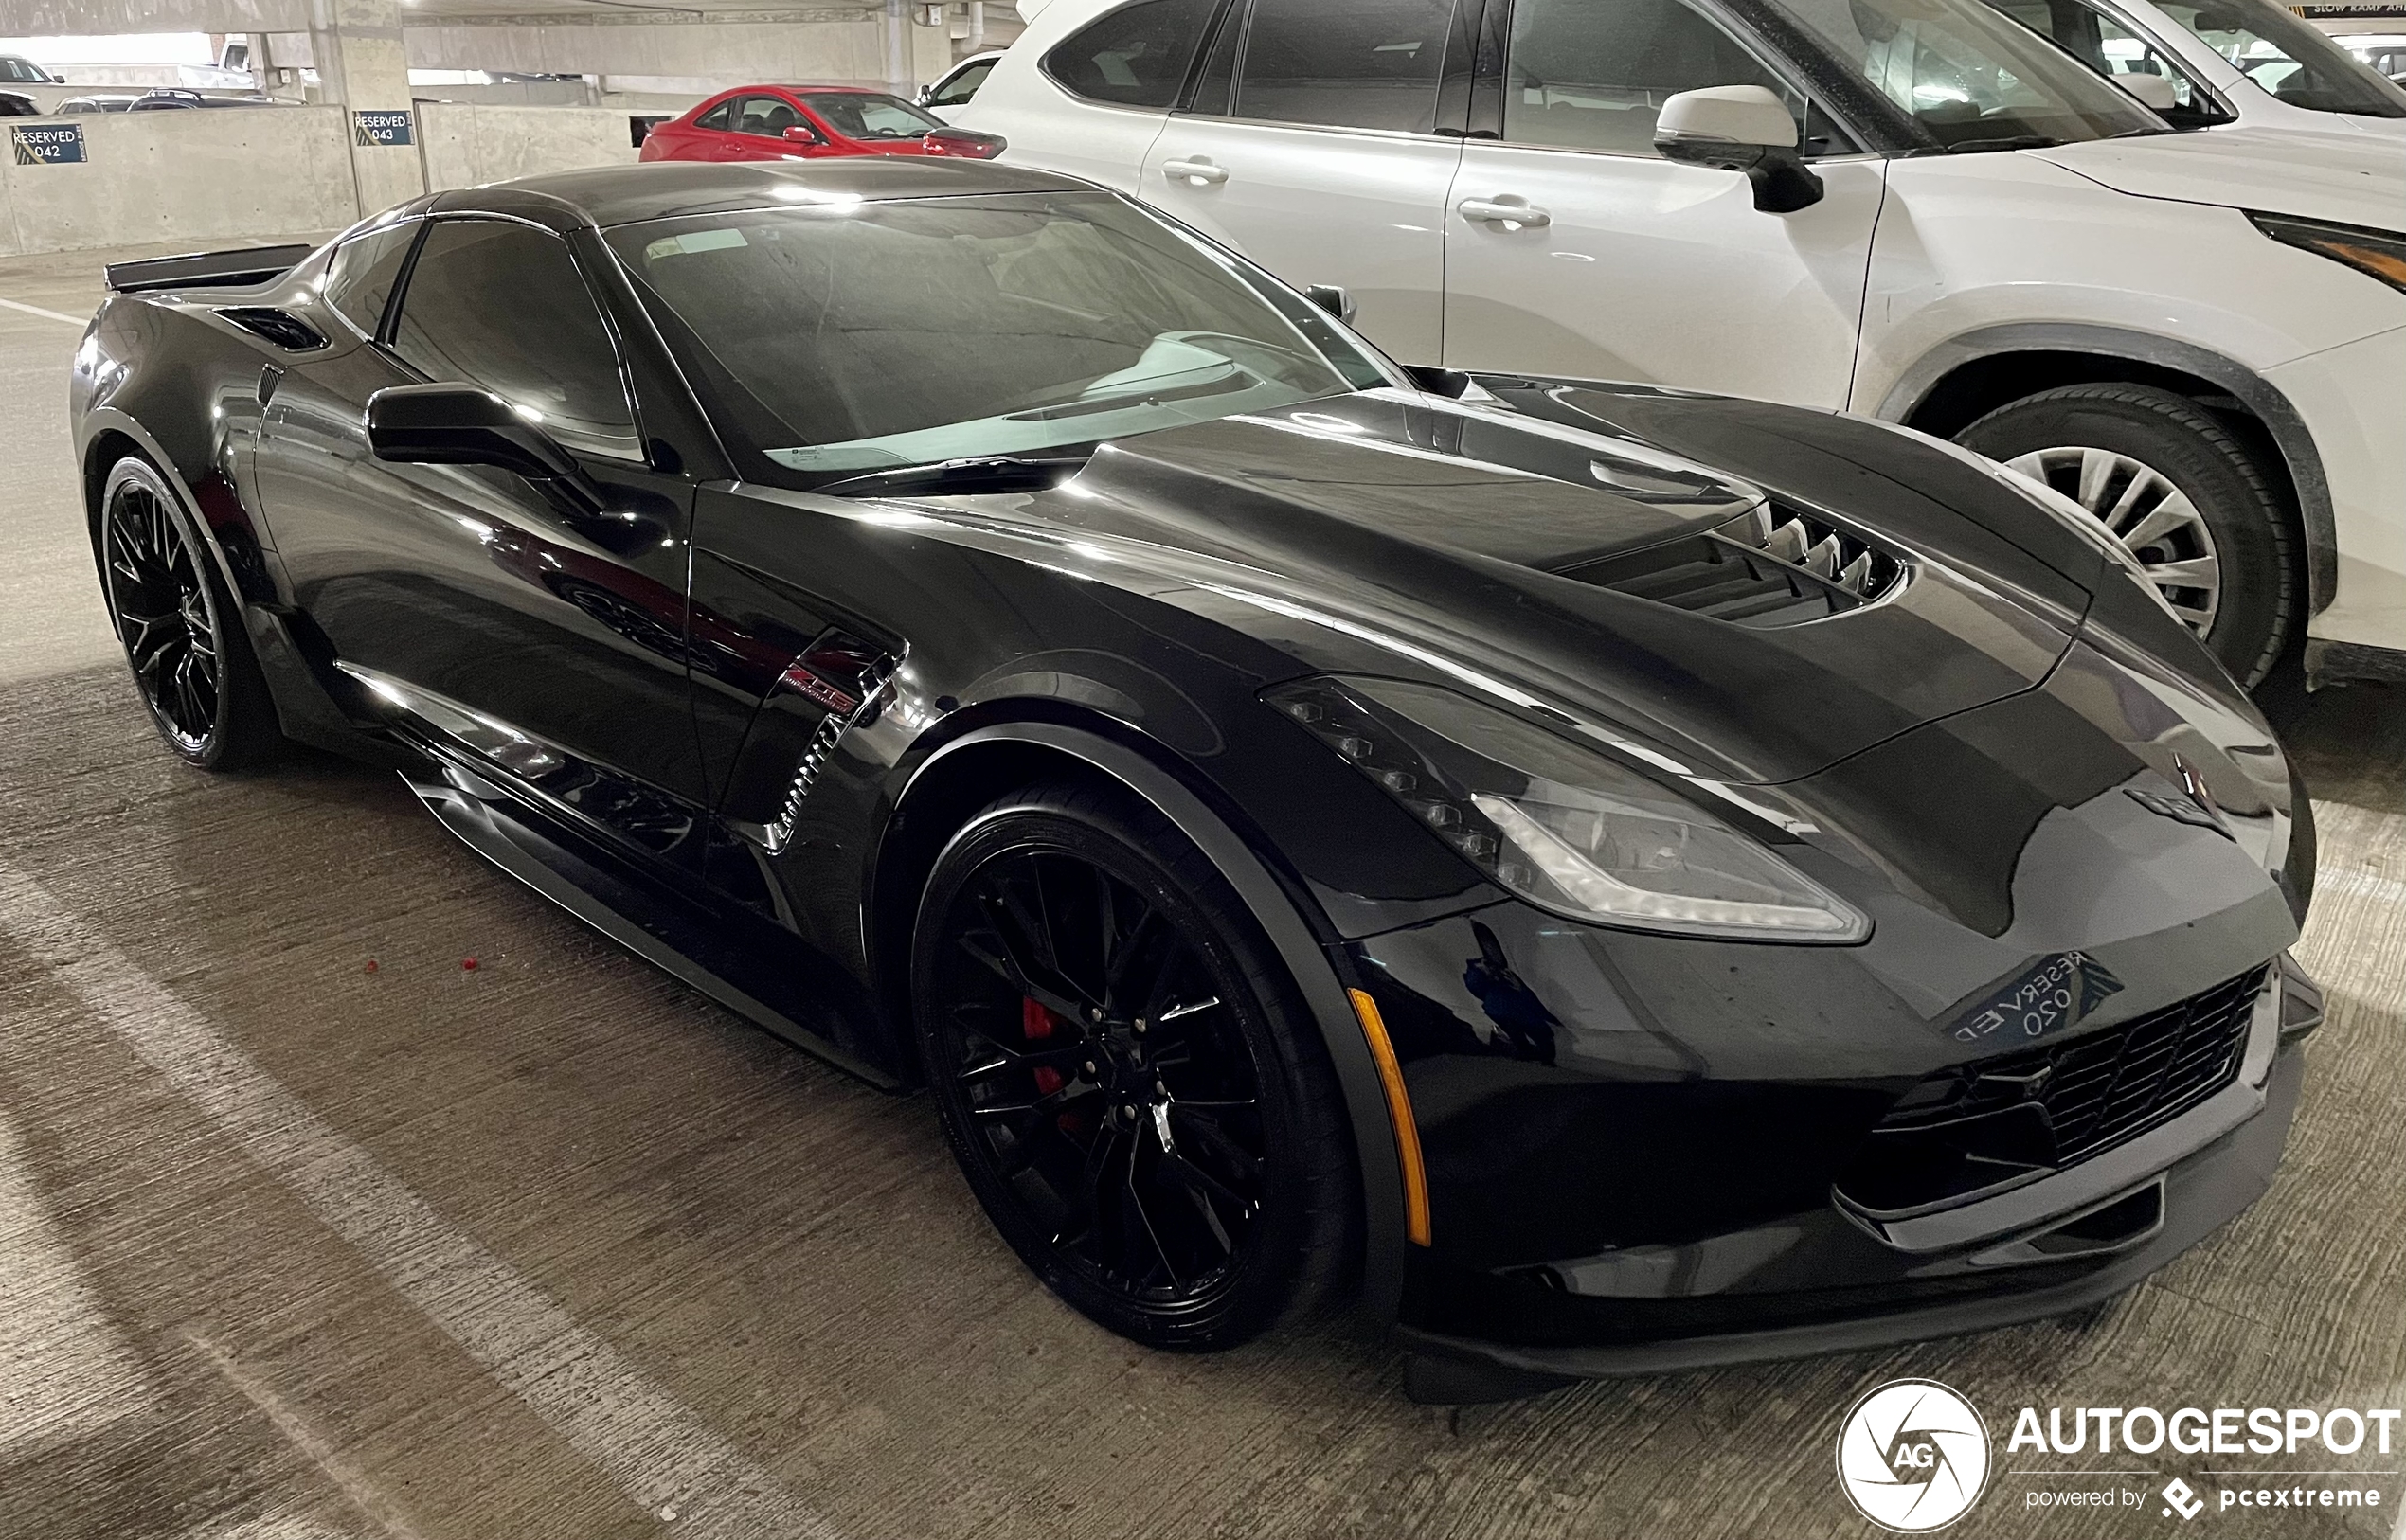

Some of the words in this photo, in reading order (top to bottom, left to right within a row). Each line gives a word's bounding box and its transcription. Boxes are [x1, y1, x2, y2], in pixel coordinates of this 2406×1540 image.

[355, 116, 405, 127] RESERVED
[13, 131, 75, 144] RESERVED
[372, 129, 393, 140] 043
[34, 145, 61, 157] 042
